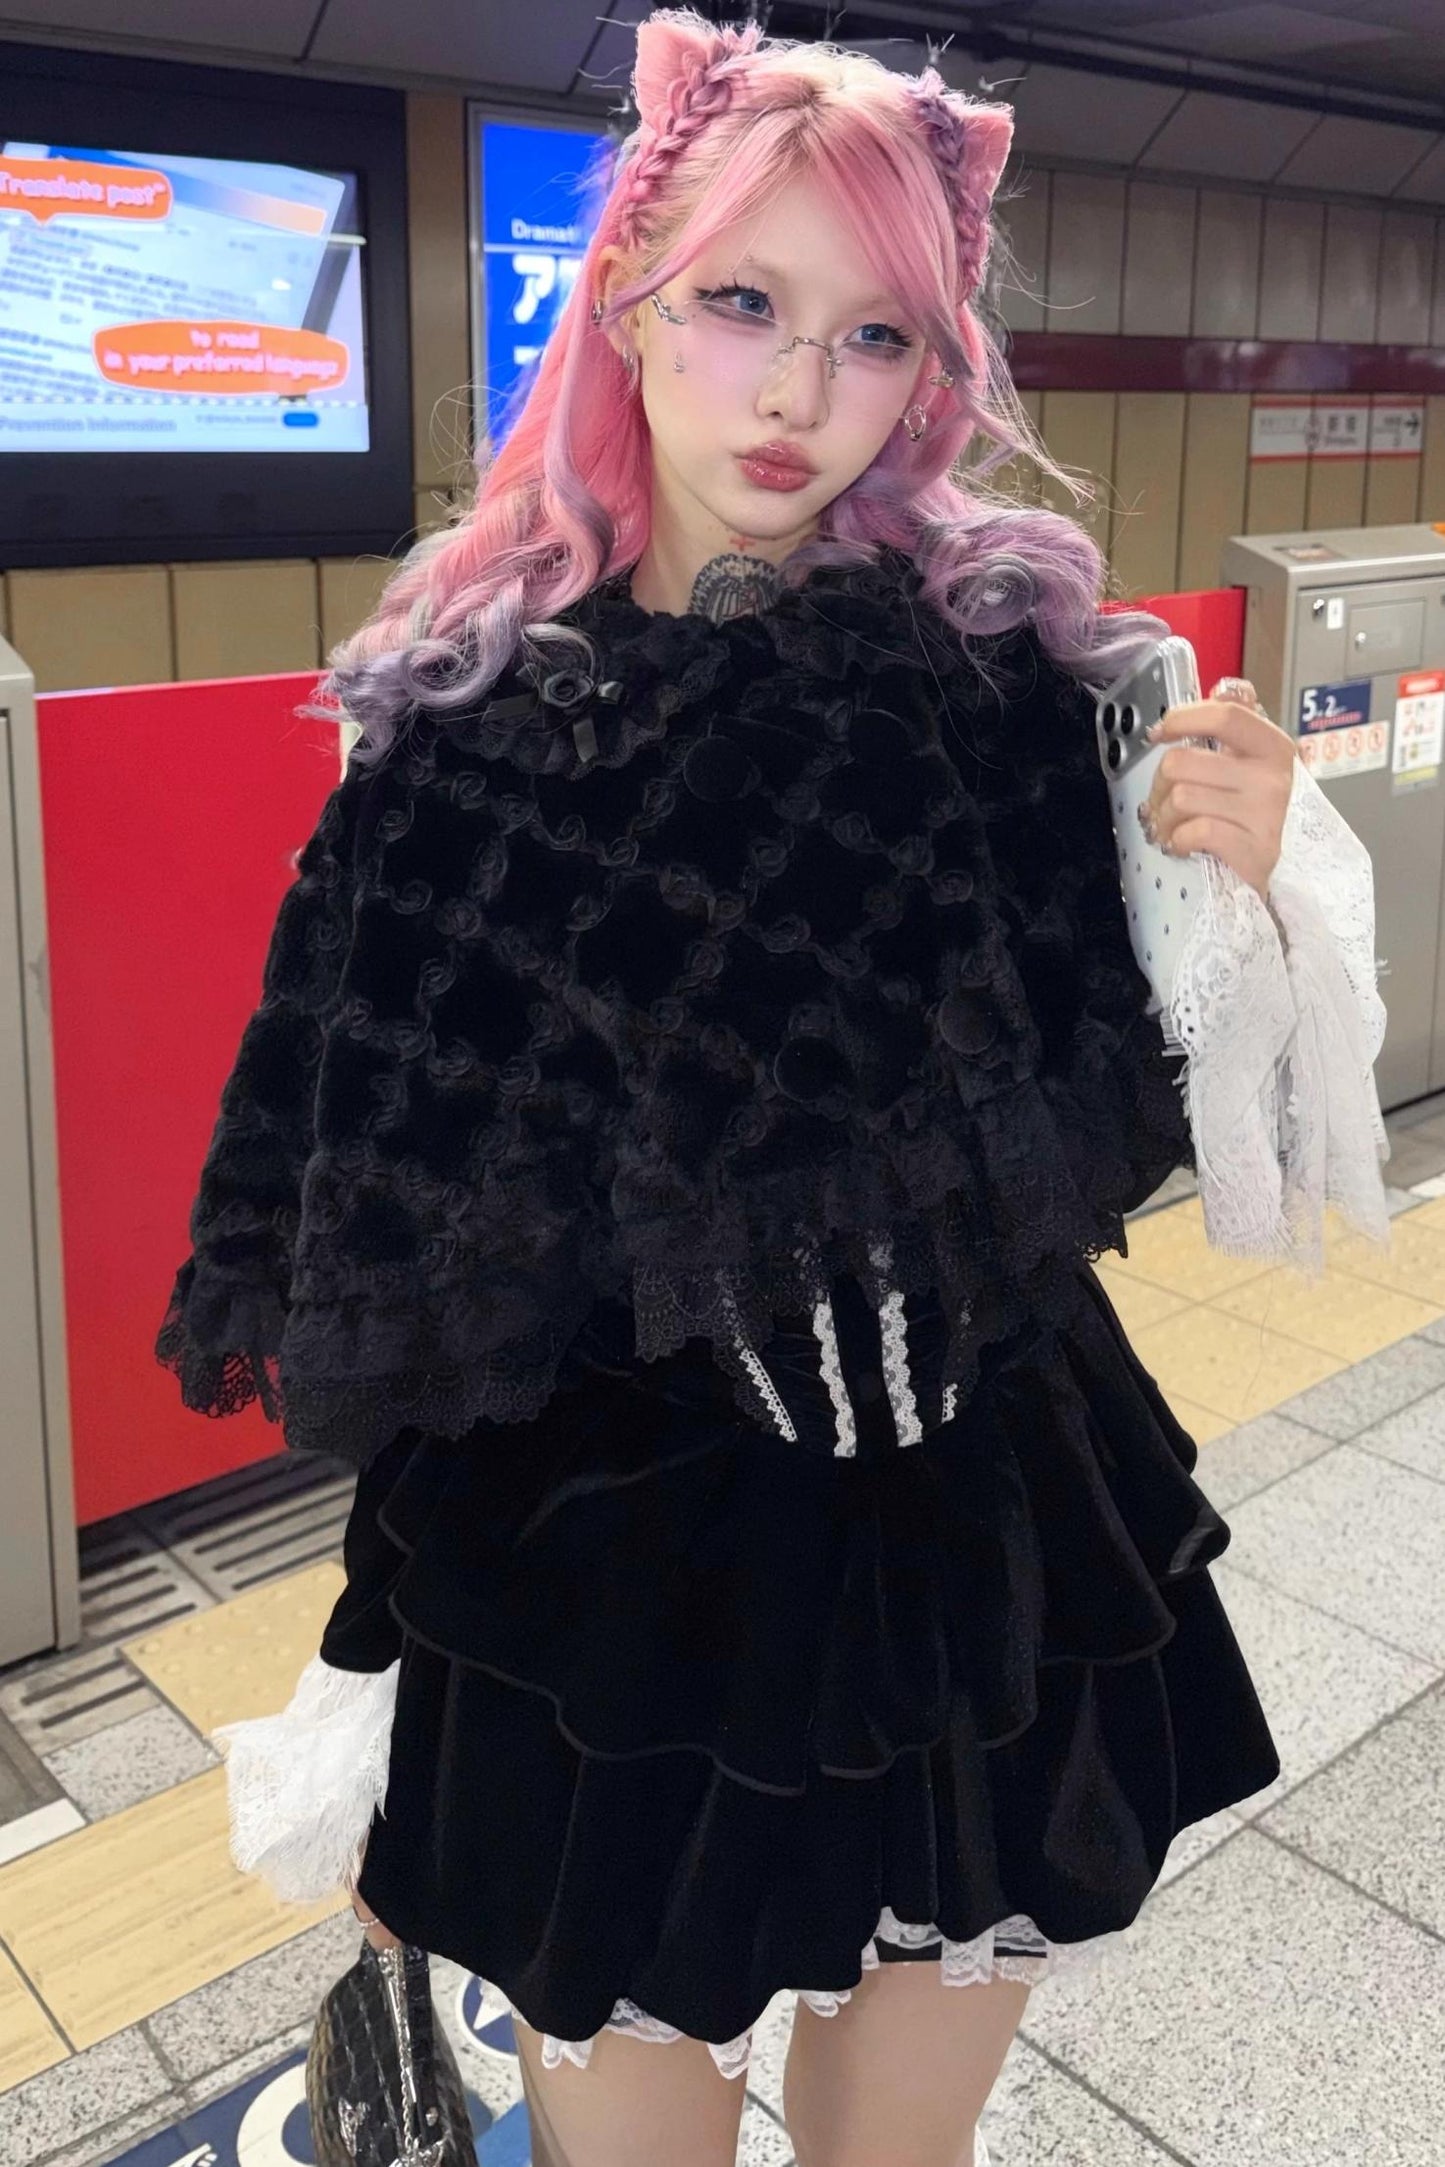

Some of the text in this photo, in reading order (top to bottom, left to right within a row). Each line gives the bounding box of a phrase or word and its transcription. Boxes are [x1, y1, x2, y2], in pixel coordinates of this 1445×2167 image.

[190, 330, 260, 349] to read
[128, 354, 170, 376] your
[173, 351, 265, 376] preferred
[265, 354, 338, 380] language
